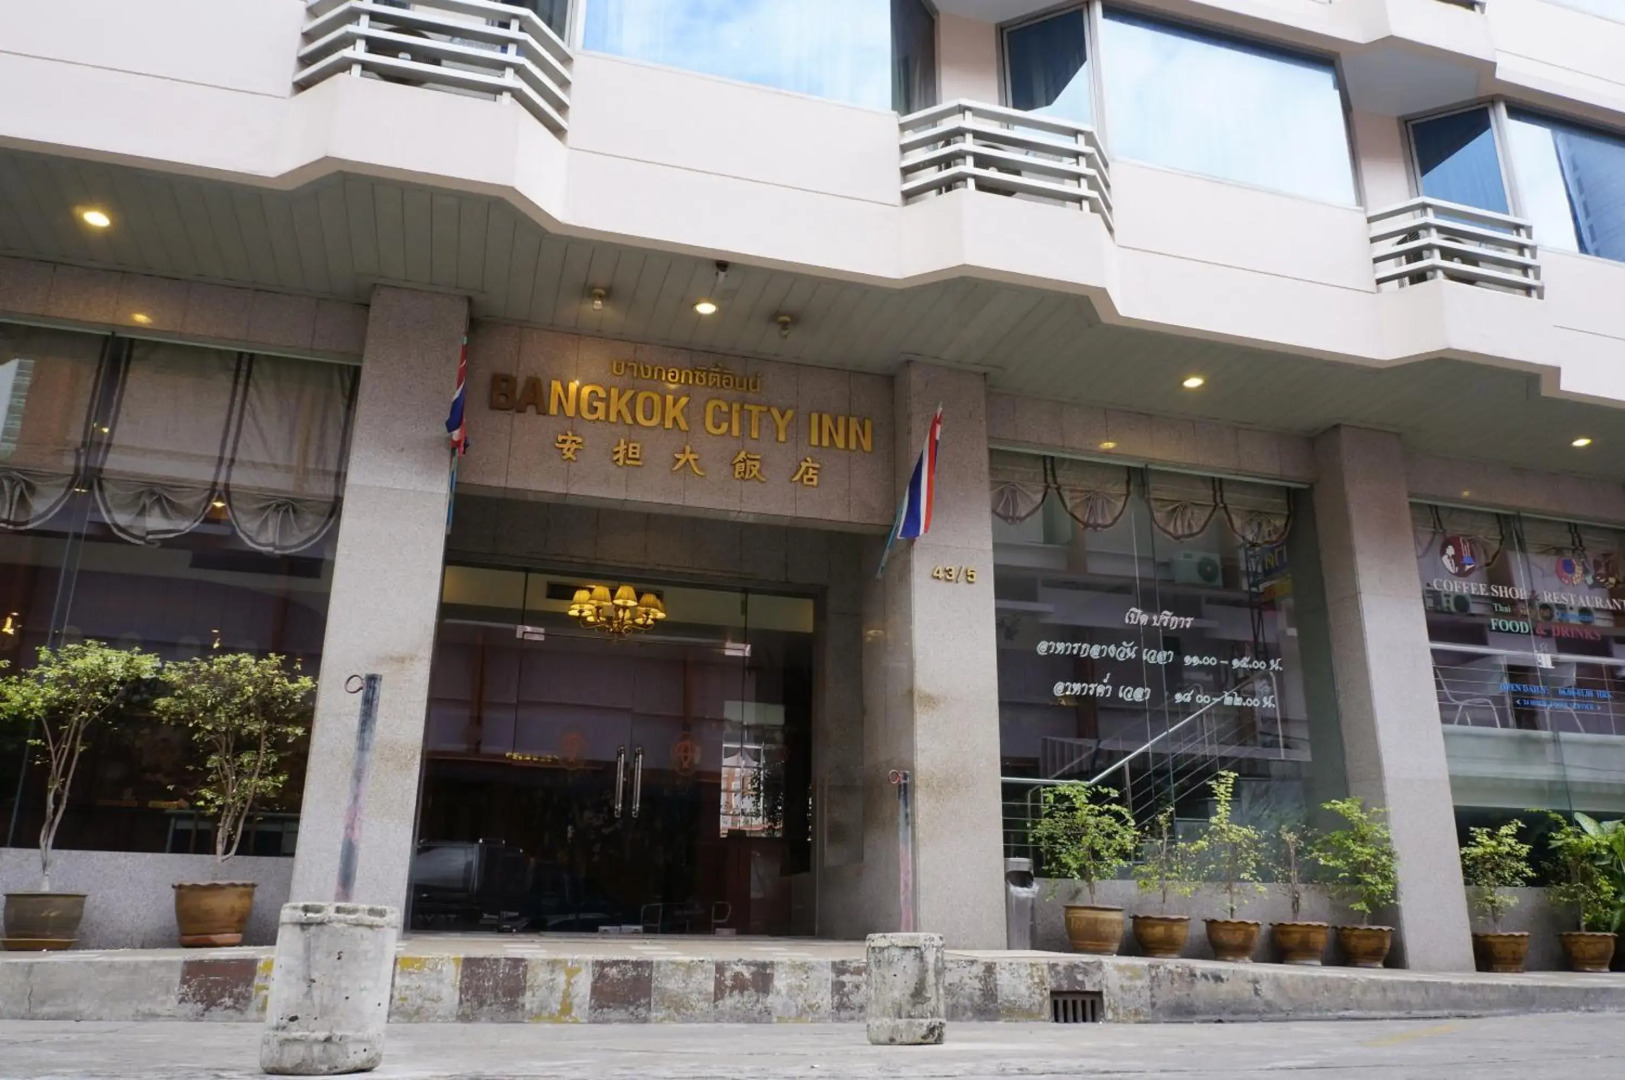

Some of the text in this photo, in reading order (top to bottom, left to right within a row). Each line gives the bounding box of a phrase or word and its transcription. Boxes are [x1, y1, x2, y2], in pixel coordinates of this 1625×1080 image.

[489, 373, 872, 452] BANGKOK CITY INN
[932, 565, 977, 584] 43/5
[1433, 578, 1488, 596] COFFEE
[1491, 584, 1528, 600] SHOP
[1125, 607, 1149, 625] เปิด
[1490, 618, 1530, 634] FOOD
[1552, 625, 1600, 640] DRINKS
[1142, 648, 1174, 664] เวลา
[1119, 685, 1151, 702] เวลา
